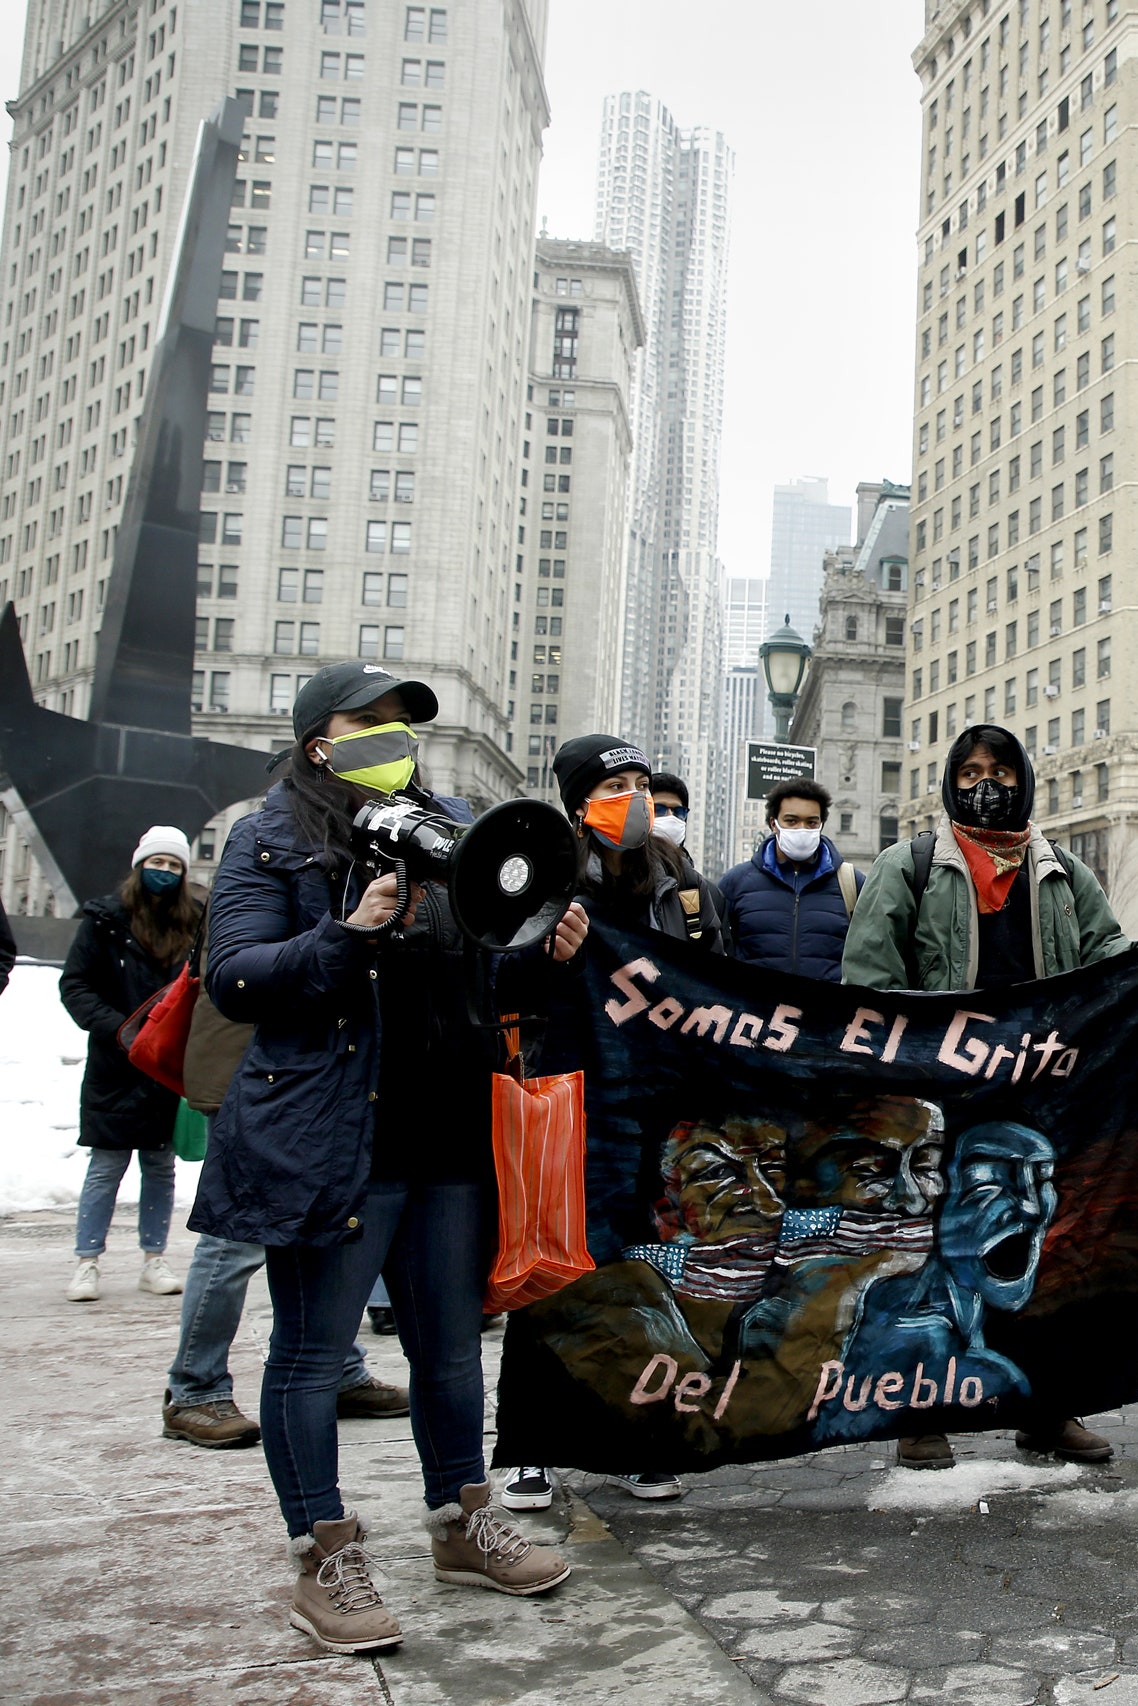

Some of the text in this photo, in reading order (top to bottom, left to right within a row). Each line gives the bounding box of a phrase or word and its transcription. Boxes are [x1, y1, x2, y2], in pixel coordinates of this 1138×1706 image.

[608, 748, 628, 757] BLACK
[784, 751, 805, 760] bicycles,
[612, 755, 629, 764] LIVES
[751, 756, 781, 765] skateboards,
[795, 760, 812, 769] skating
[432, 836, 455, 853] PYLE
[604, 957, 1079, 1085] Somos El Grito
[629, 1353, 742, 1420] Del
